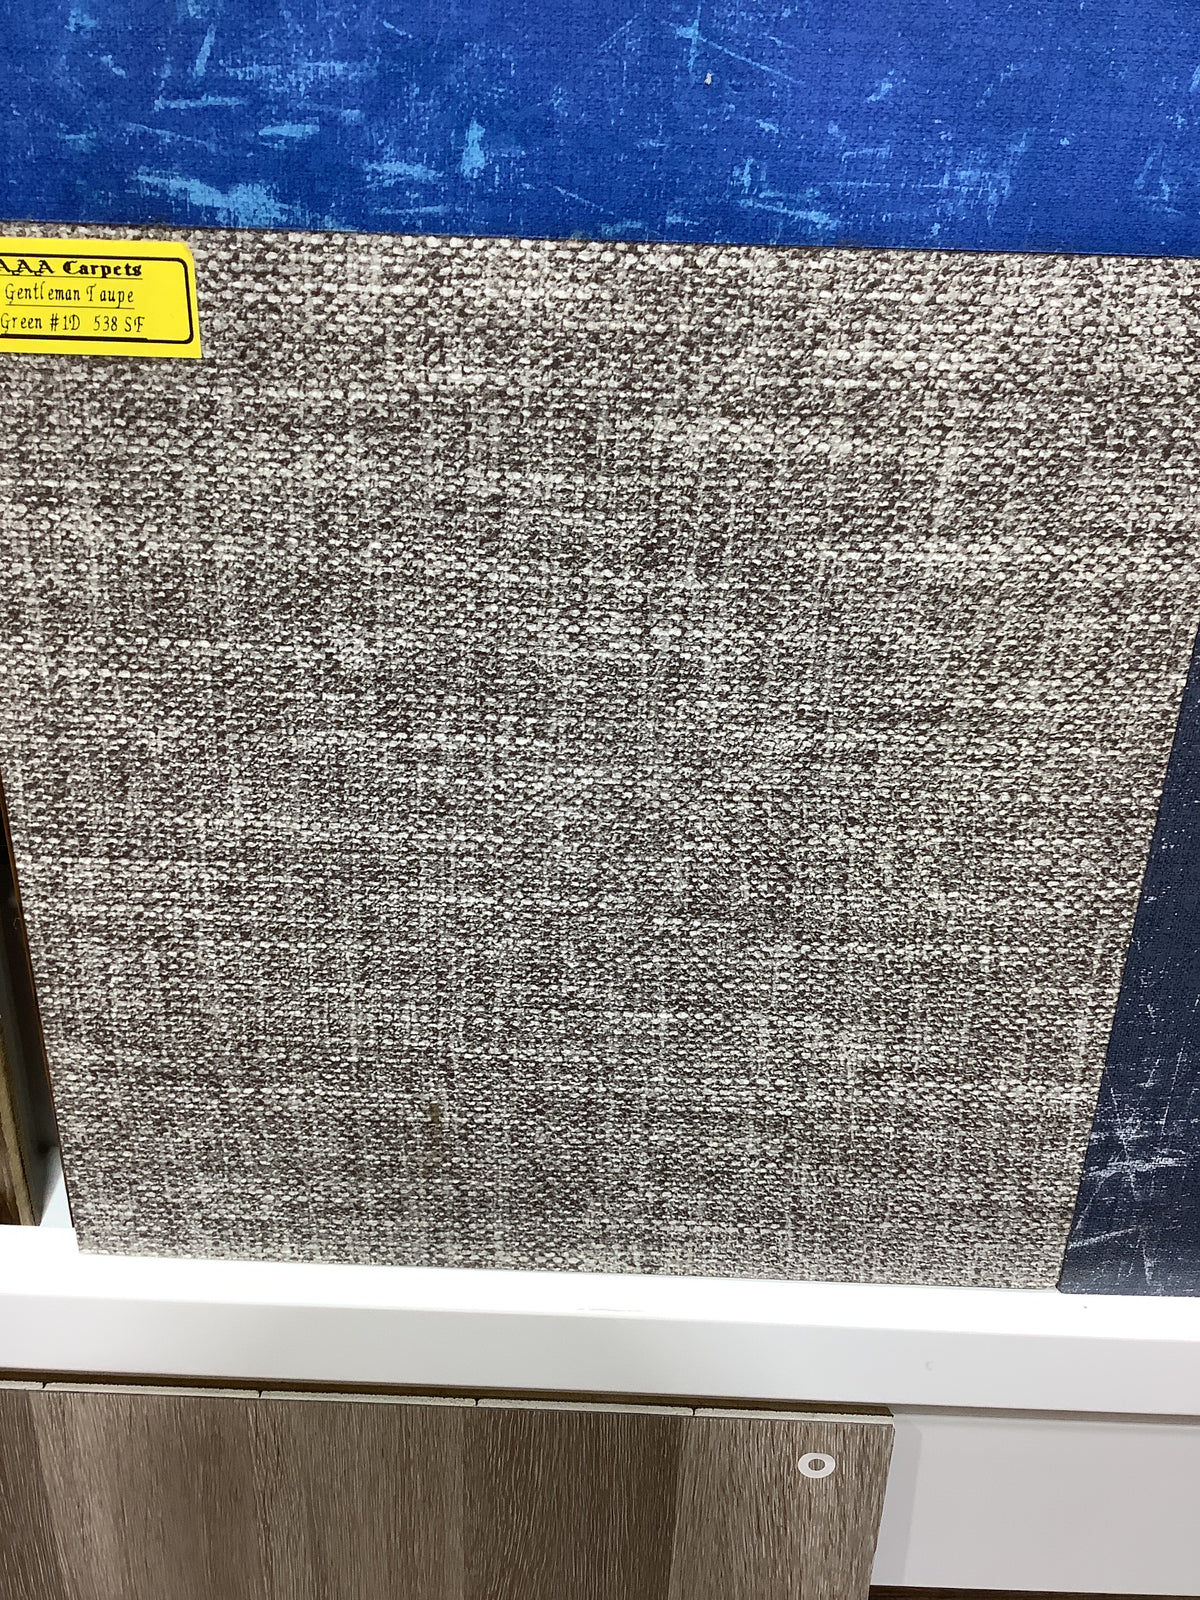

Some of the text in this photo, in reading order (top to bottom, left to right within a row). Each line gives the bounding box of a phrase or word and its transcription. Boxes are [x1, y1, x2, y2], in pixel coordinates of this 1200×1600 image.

[62, 260, 143, 279] Carpets
[5, 281, 135, 309] Gentleman Taupe
[0, 313, 146, 334] Green #1D 538 SF
